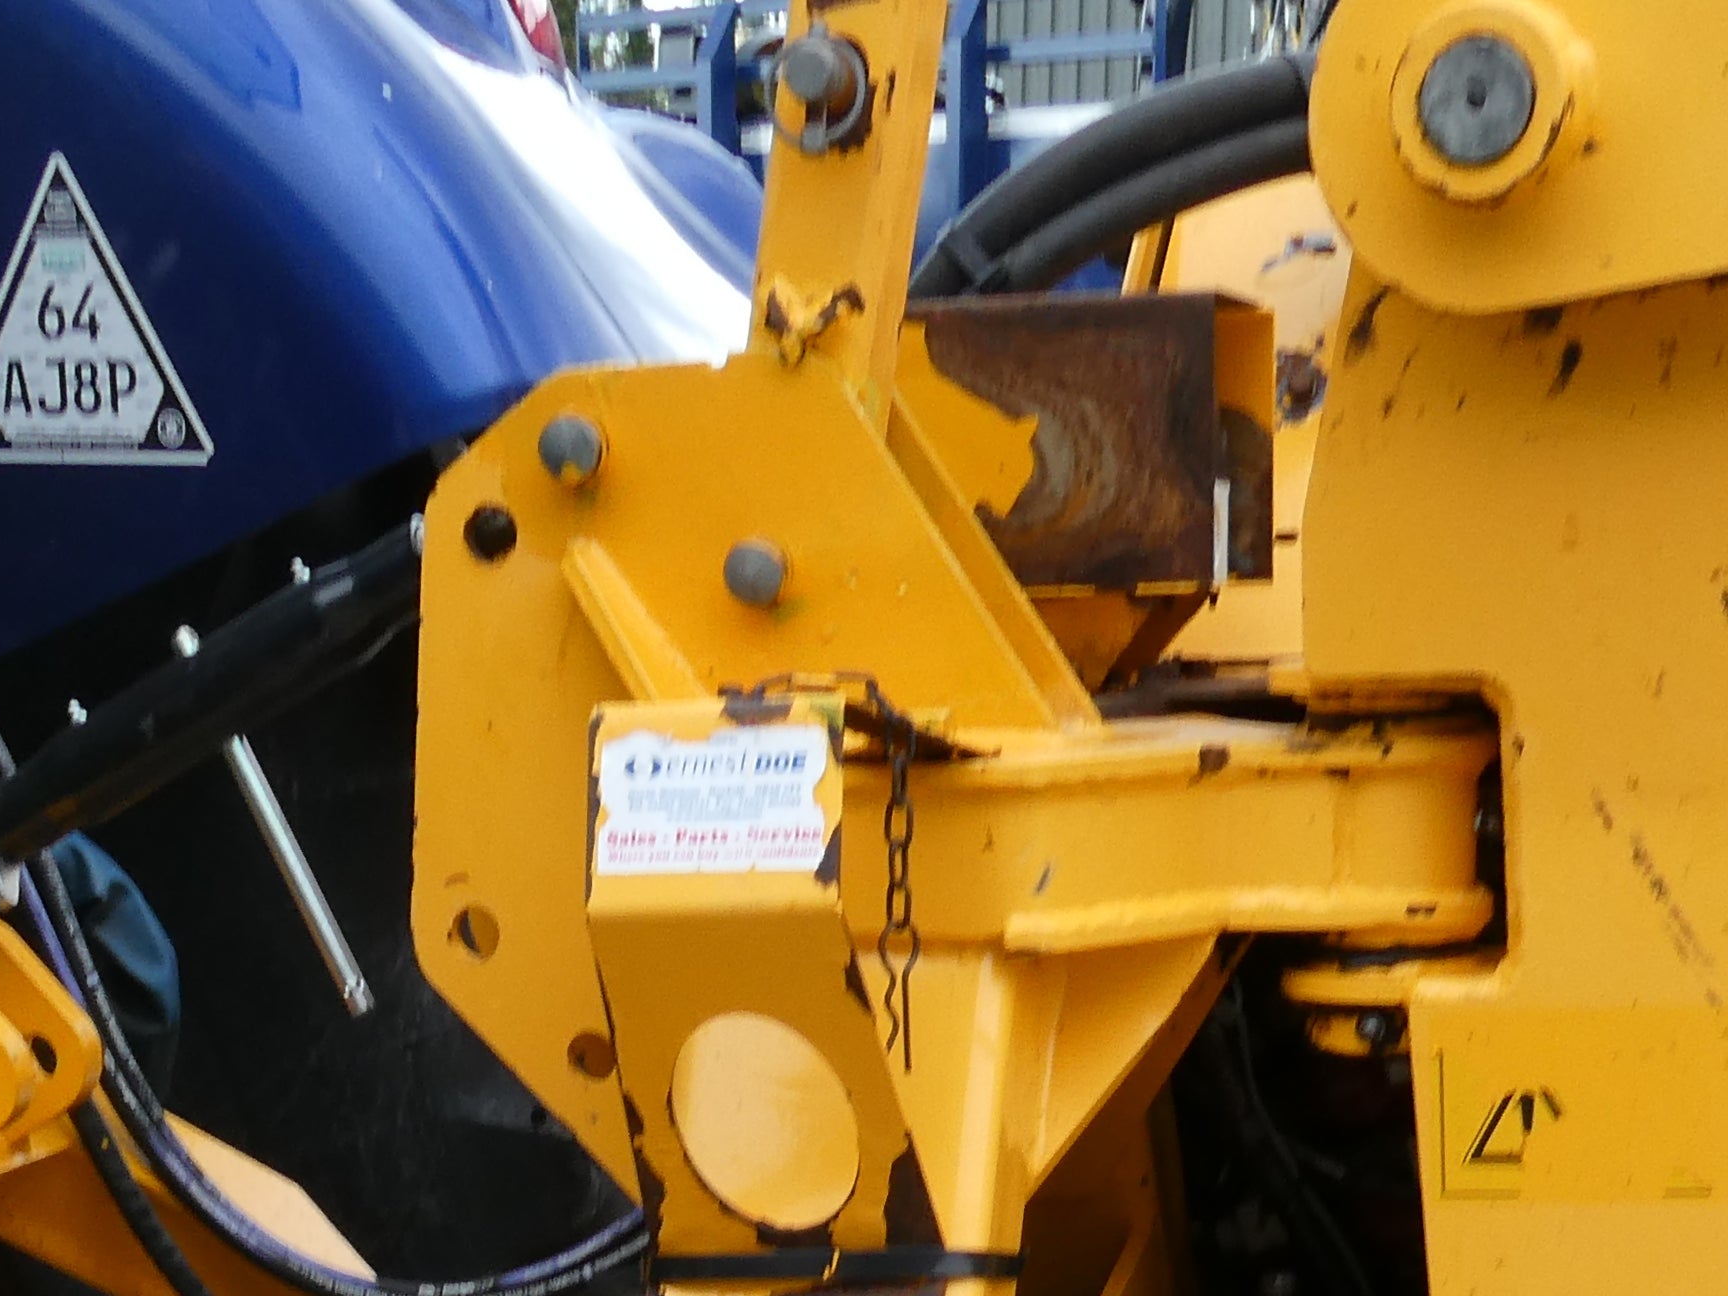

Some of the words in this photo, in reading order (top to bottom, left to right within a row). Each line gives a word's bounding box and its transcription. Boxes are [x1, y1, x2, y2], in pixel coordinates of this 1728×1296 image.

[37, 281, 101, 343] 64
[3, 358, 138, 417] AJ8P
[754, 750, 807, 775] DOE
